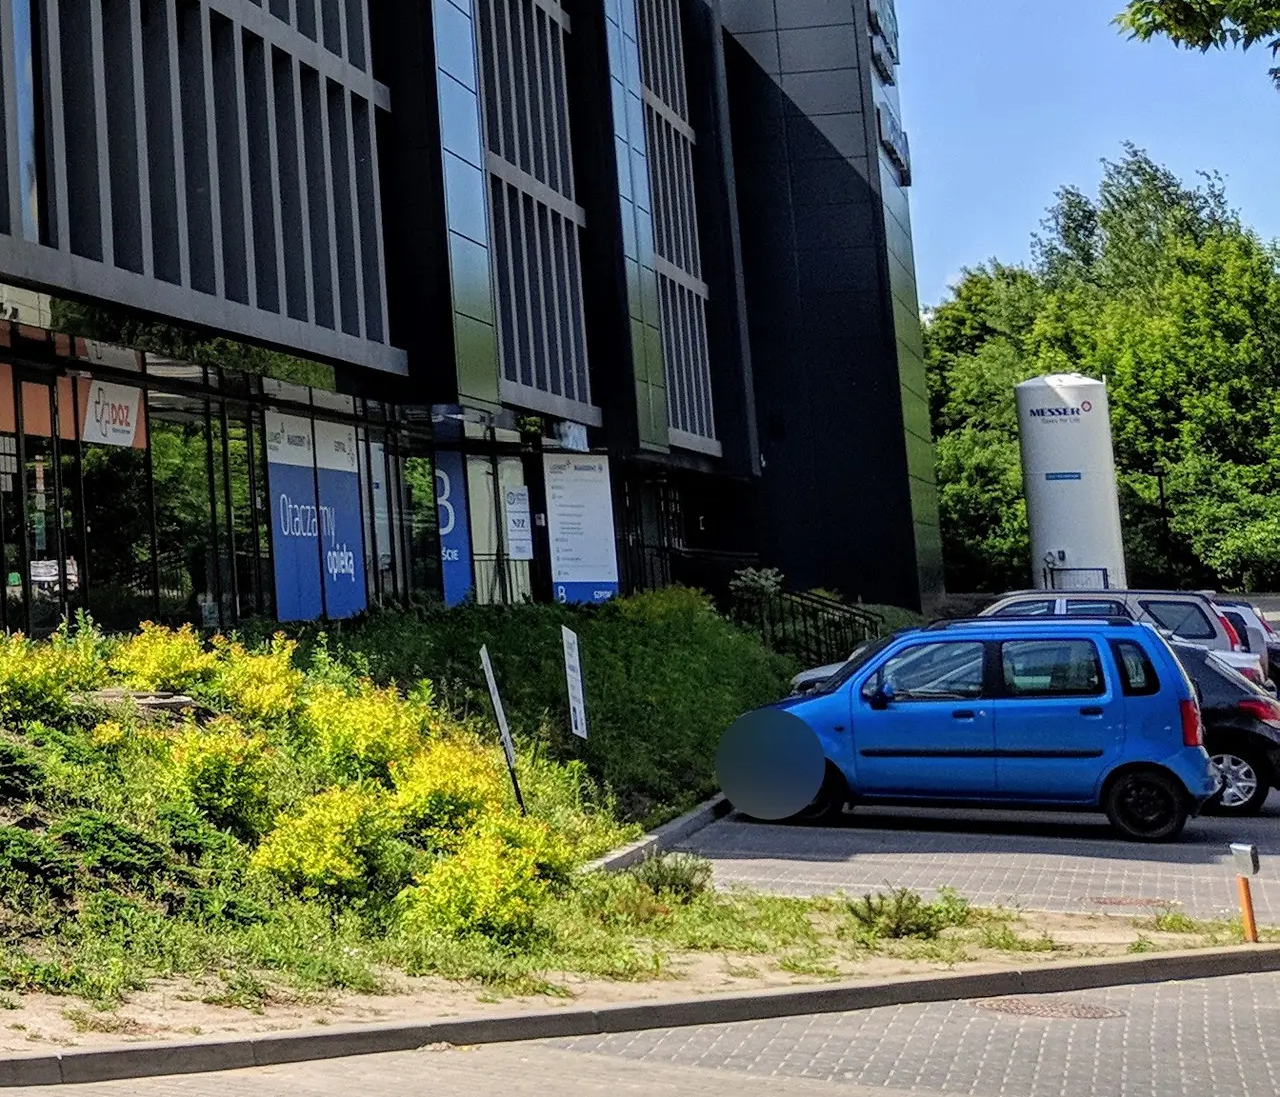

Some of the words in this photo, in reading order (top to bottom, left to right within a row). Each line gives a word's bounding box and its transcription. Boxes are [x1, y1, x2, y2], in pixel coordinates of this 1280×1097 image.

[110, 402, 131, 427] DOZ
[1029, 407, 1081, 417] MESSER
[279, 493, 336, 547] Otaczamy
[326, 543, 355, 582] opieką
